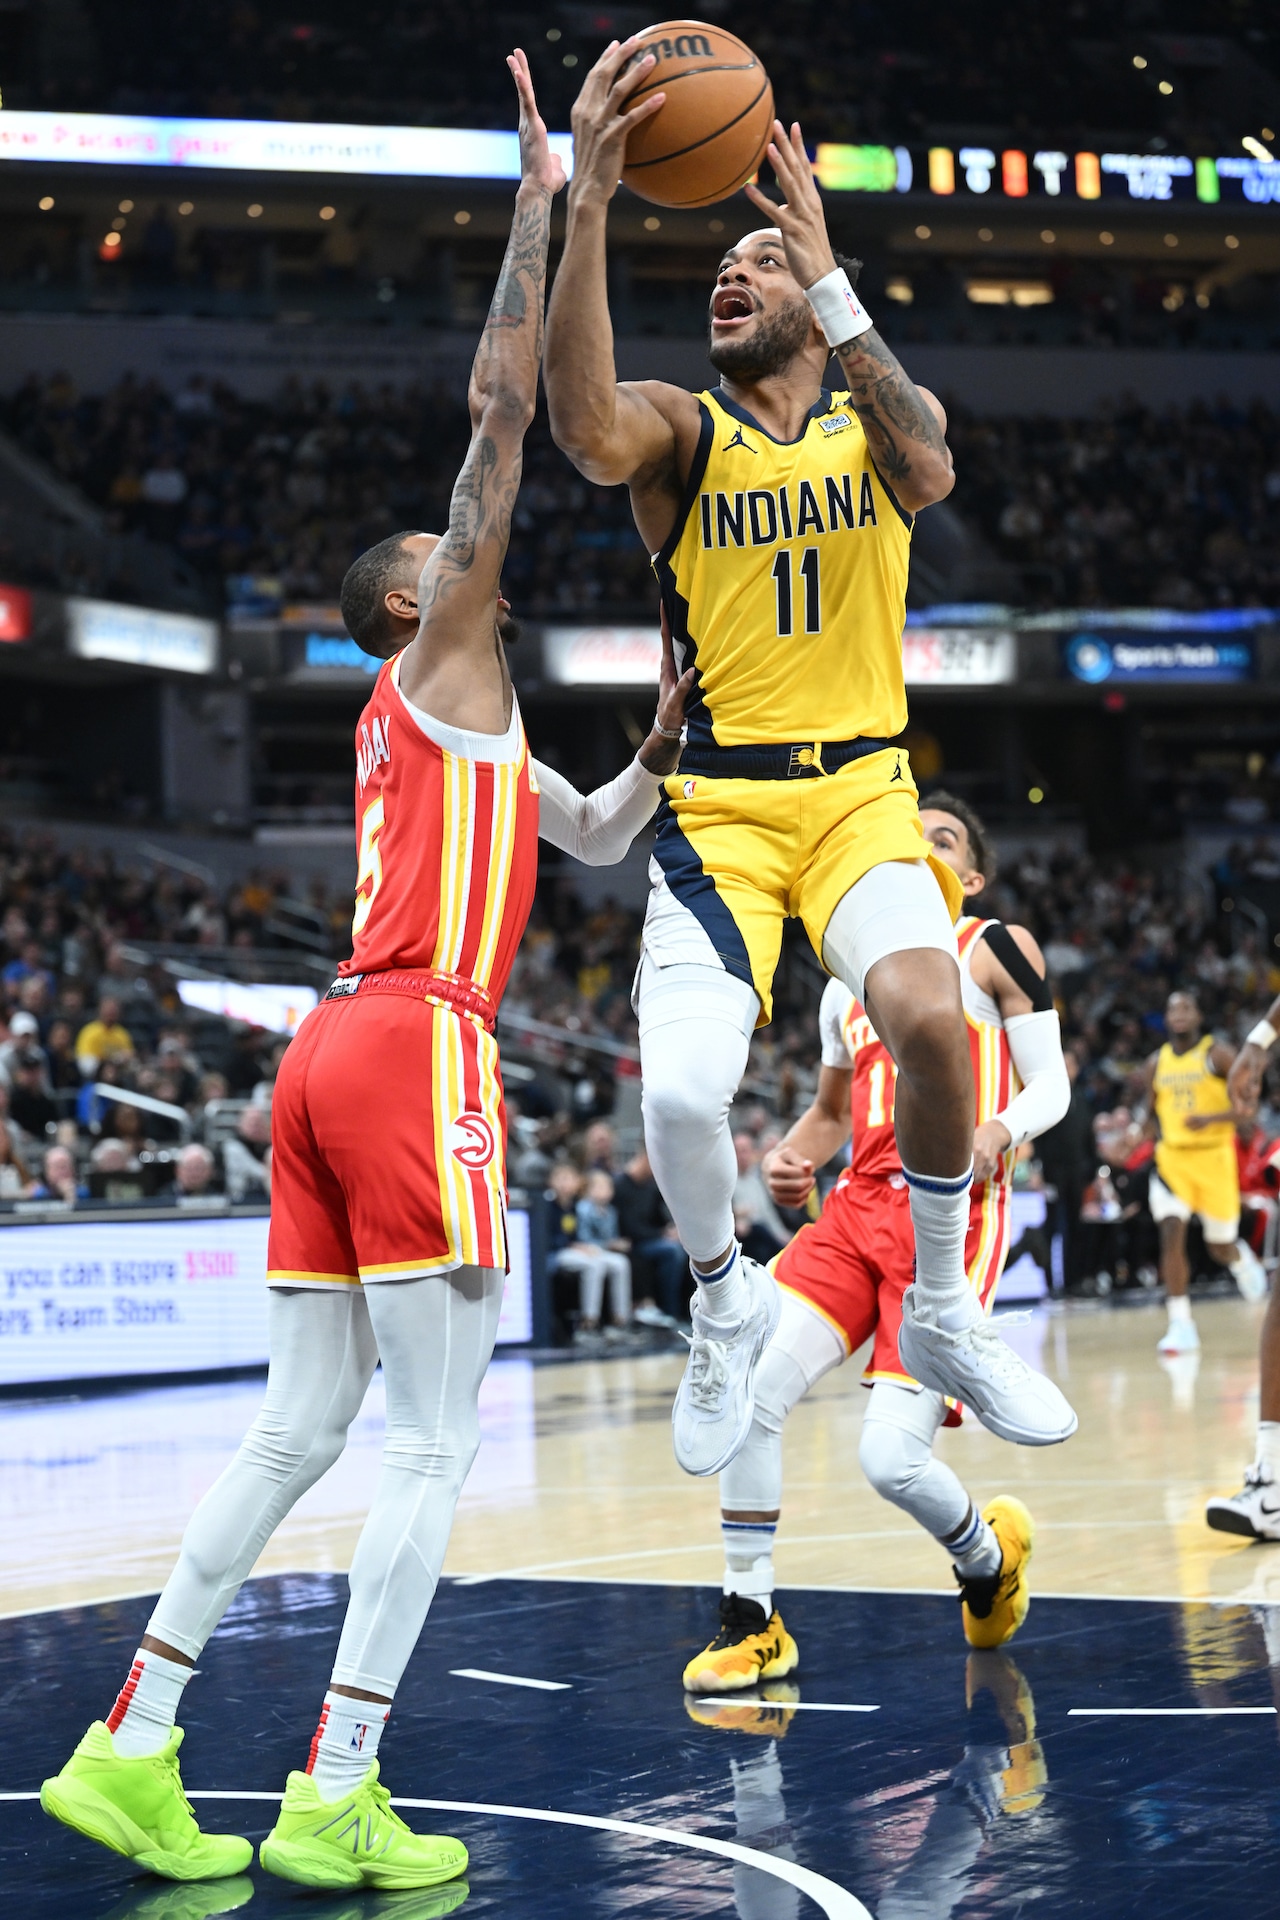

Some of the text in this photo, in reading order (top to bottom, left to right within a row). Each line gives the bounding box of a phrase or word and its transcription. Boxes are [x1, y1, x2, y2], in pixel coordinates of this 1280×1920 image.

[700, 471, 878, 549] INDIANA
[771, 546, 822, 637] 11
[352, 793, 385, 937] 5
[3, 1268, 53, 1299] you
[59, 1262, 104, 1288] can
[111, 1261, 176, 1285] score
[41, 1299, 106, 1328] Team
